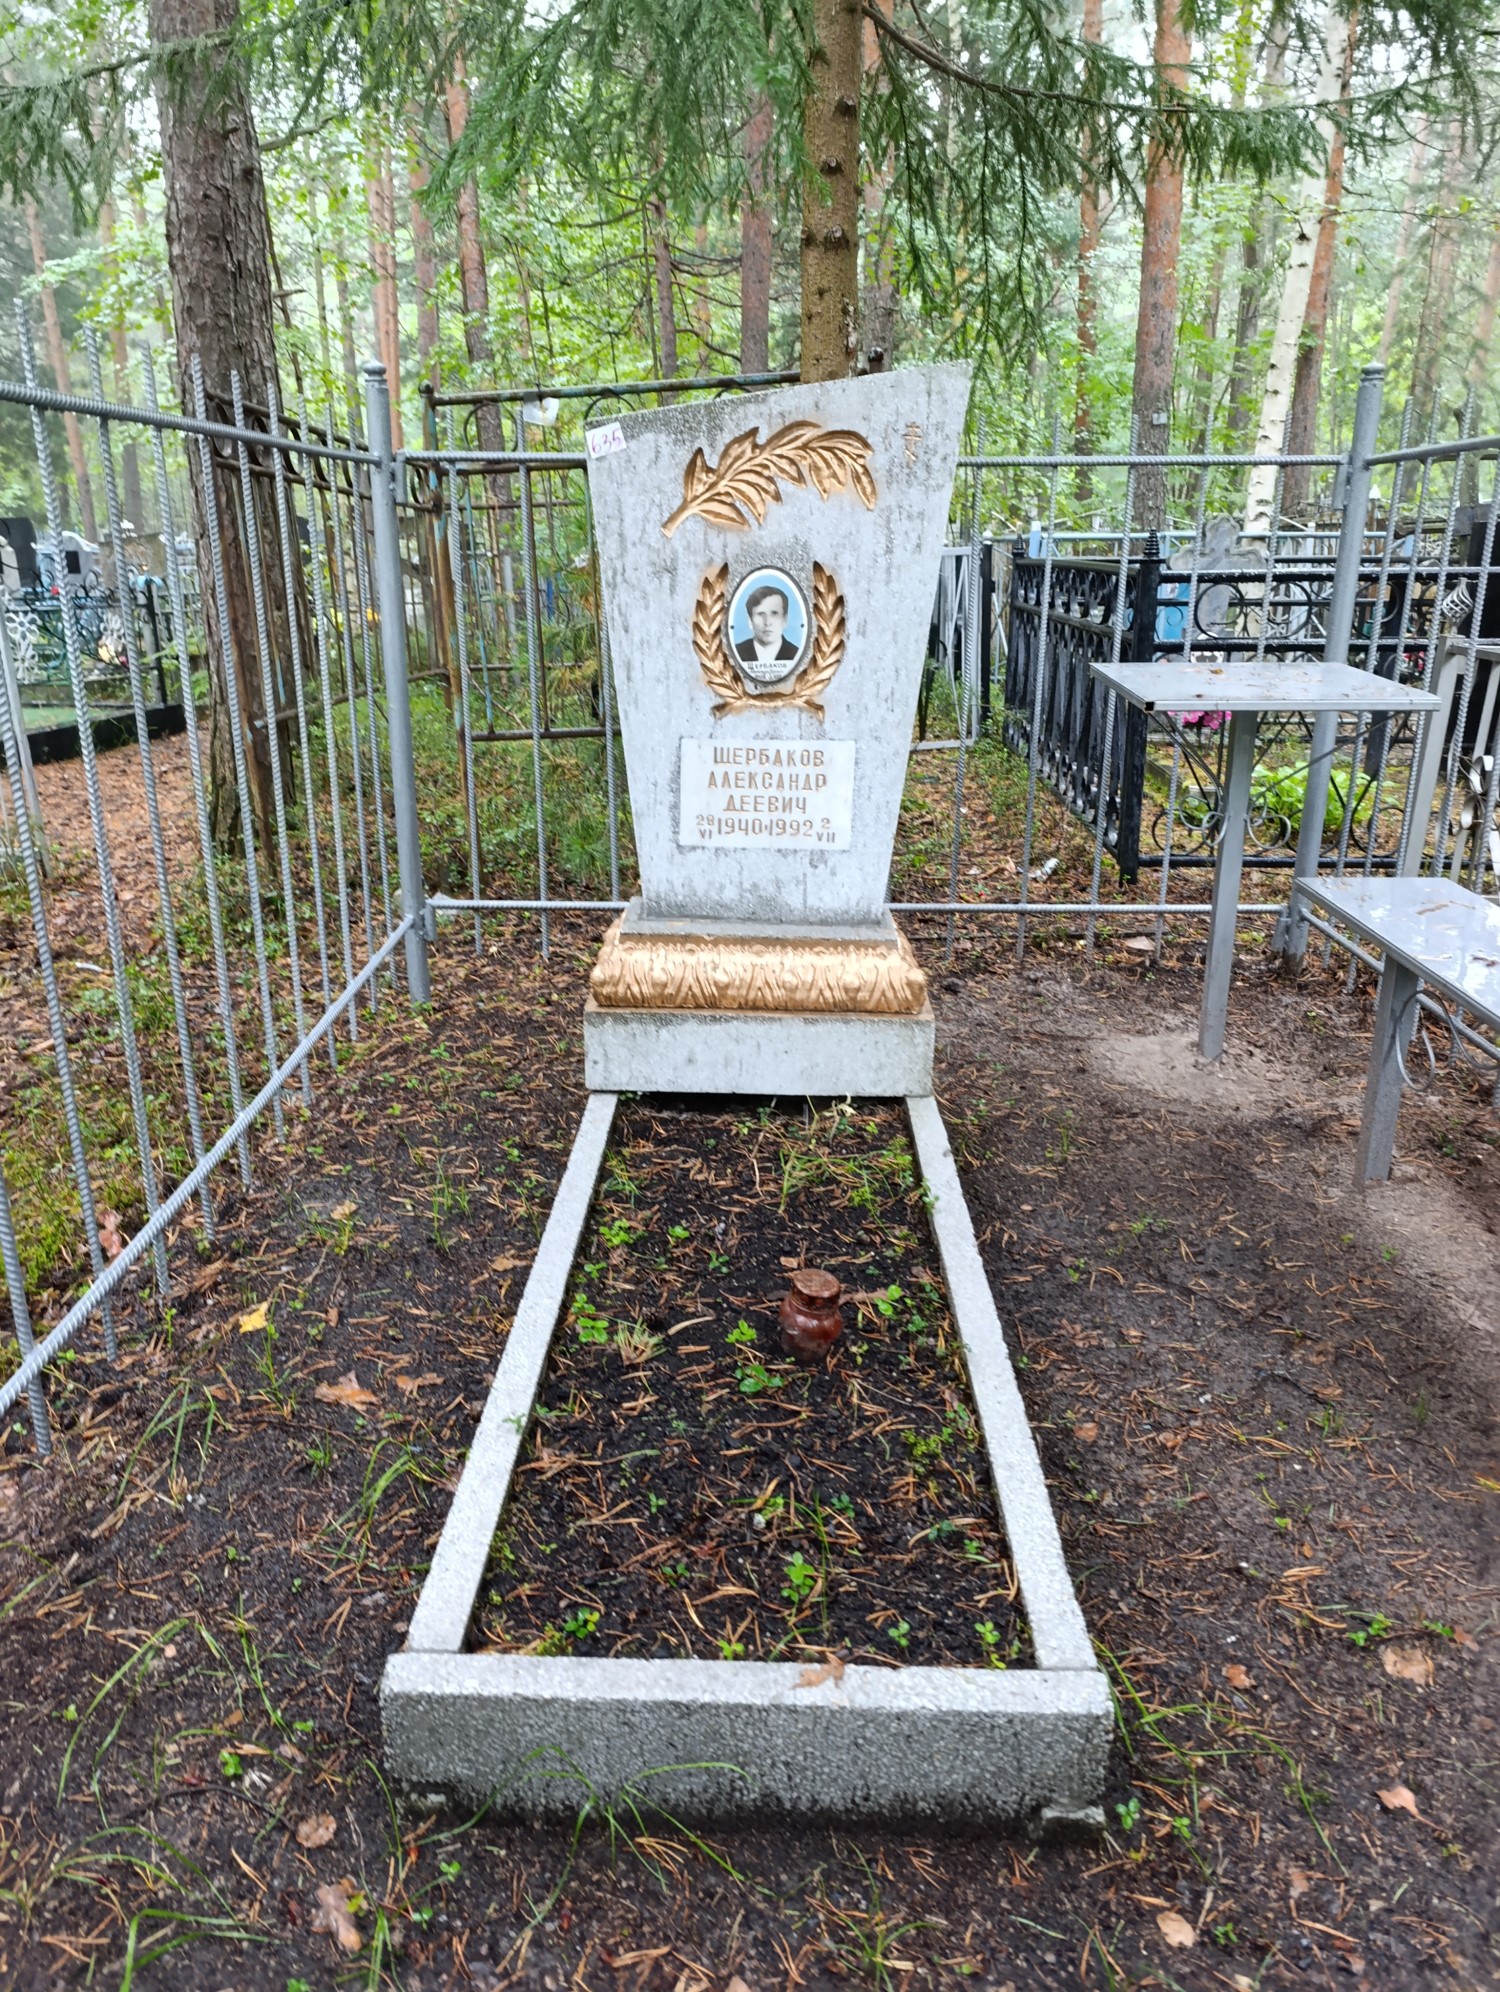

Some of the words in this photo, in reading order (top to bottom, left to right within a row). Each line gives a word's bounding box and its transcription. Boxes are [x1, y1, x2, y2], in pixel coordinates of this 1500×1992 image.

[592, 428, 622, 454] 635
[713, 746, 824, 767] ЩЕРБАКОВ
[708, 771, 827, 791] АЛЕКСАНДР
[723, 795, 807, 814] ДЕЕВИЧ
[696, 814, 715, 826] 28
[821, 817, 831, 829] 2
[699, 829, 712, 839] VI
[816, 832, 835, 843] VII
